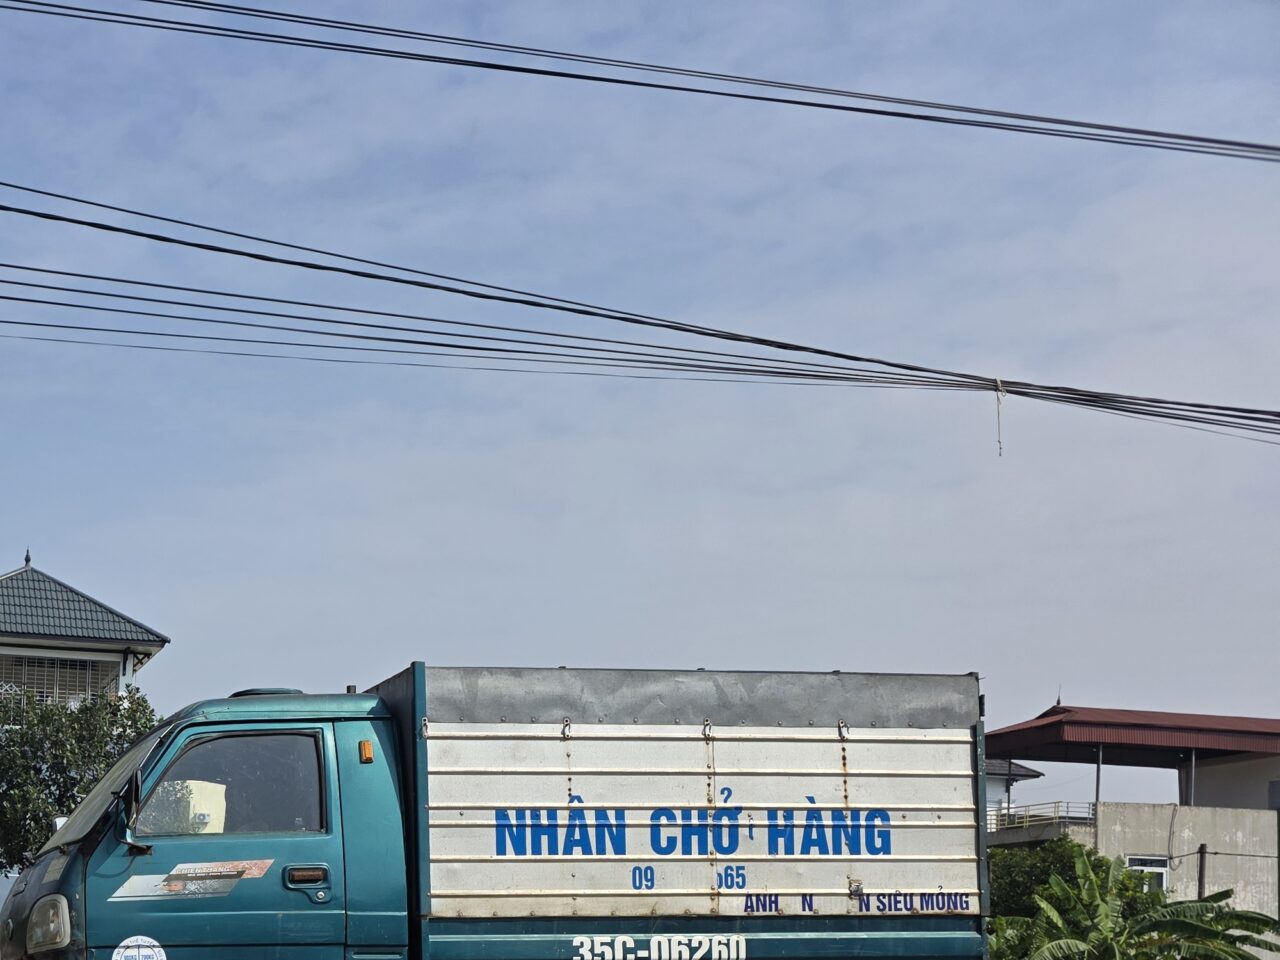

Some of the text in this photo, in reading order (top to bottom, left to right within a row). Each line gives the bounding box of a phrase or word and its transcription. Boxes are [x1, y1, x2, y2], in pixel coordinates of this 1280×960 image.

[649, 786, 743, 857] CHỞ
[766, 795, 892, 857] HÀNG
[631, 865, 655, 890] 09
[876, 889, 915, 913] SIÊU
[920, 885, 970, 912] MỎNG
